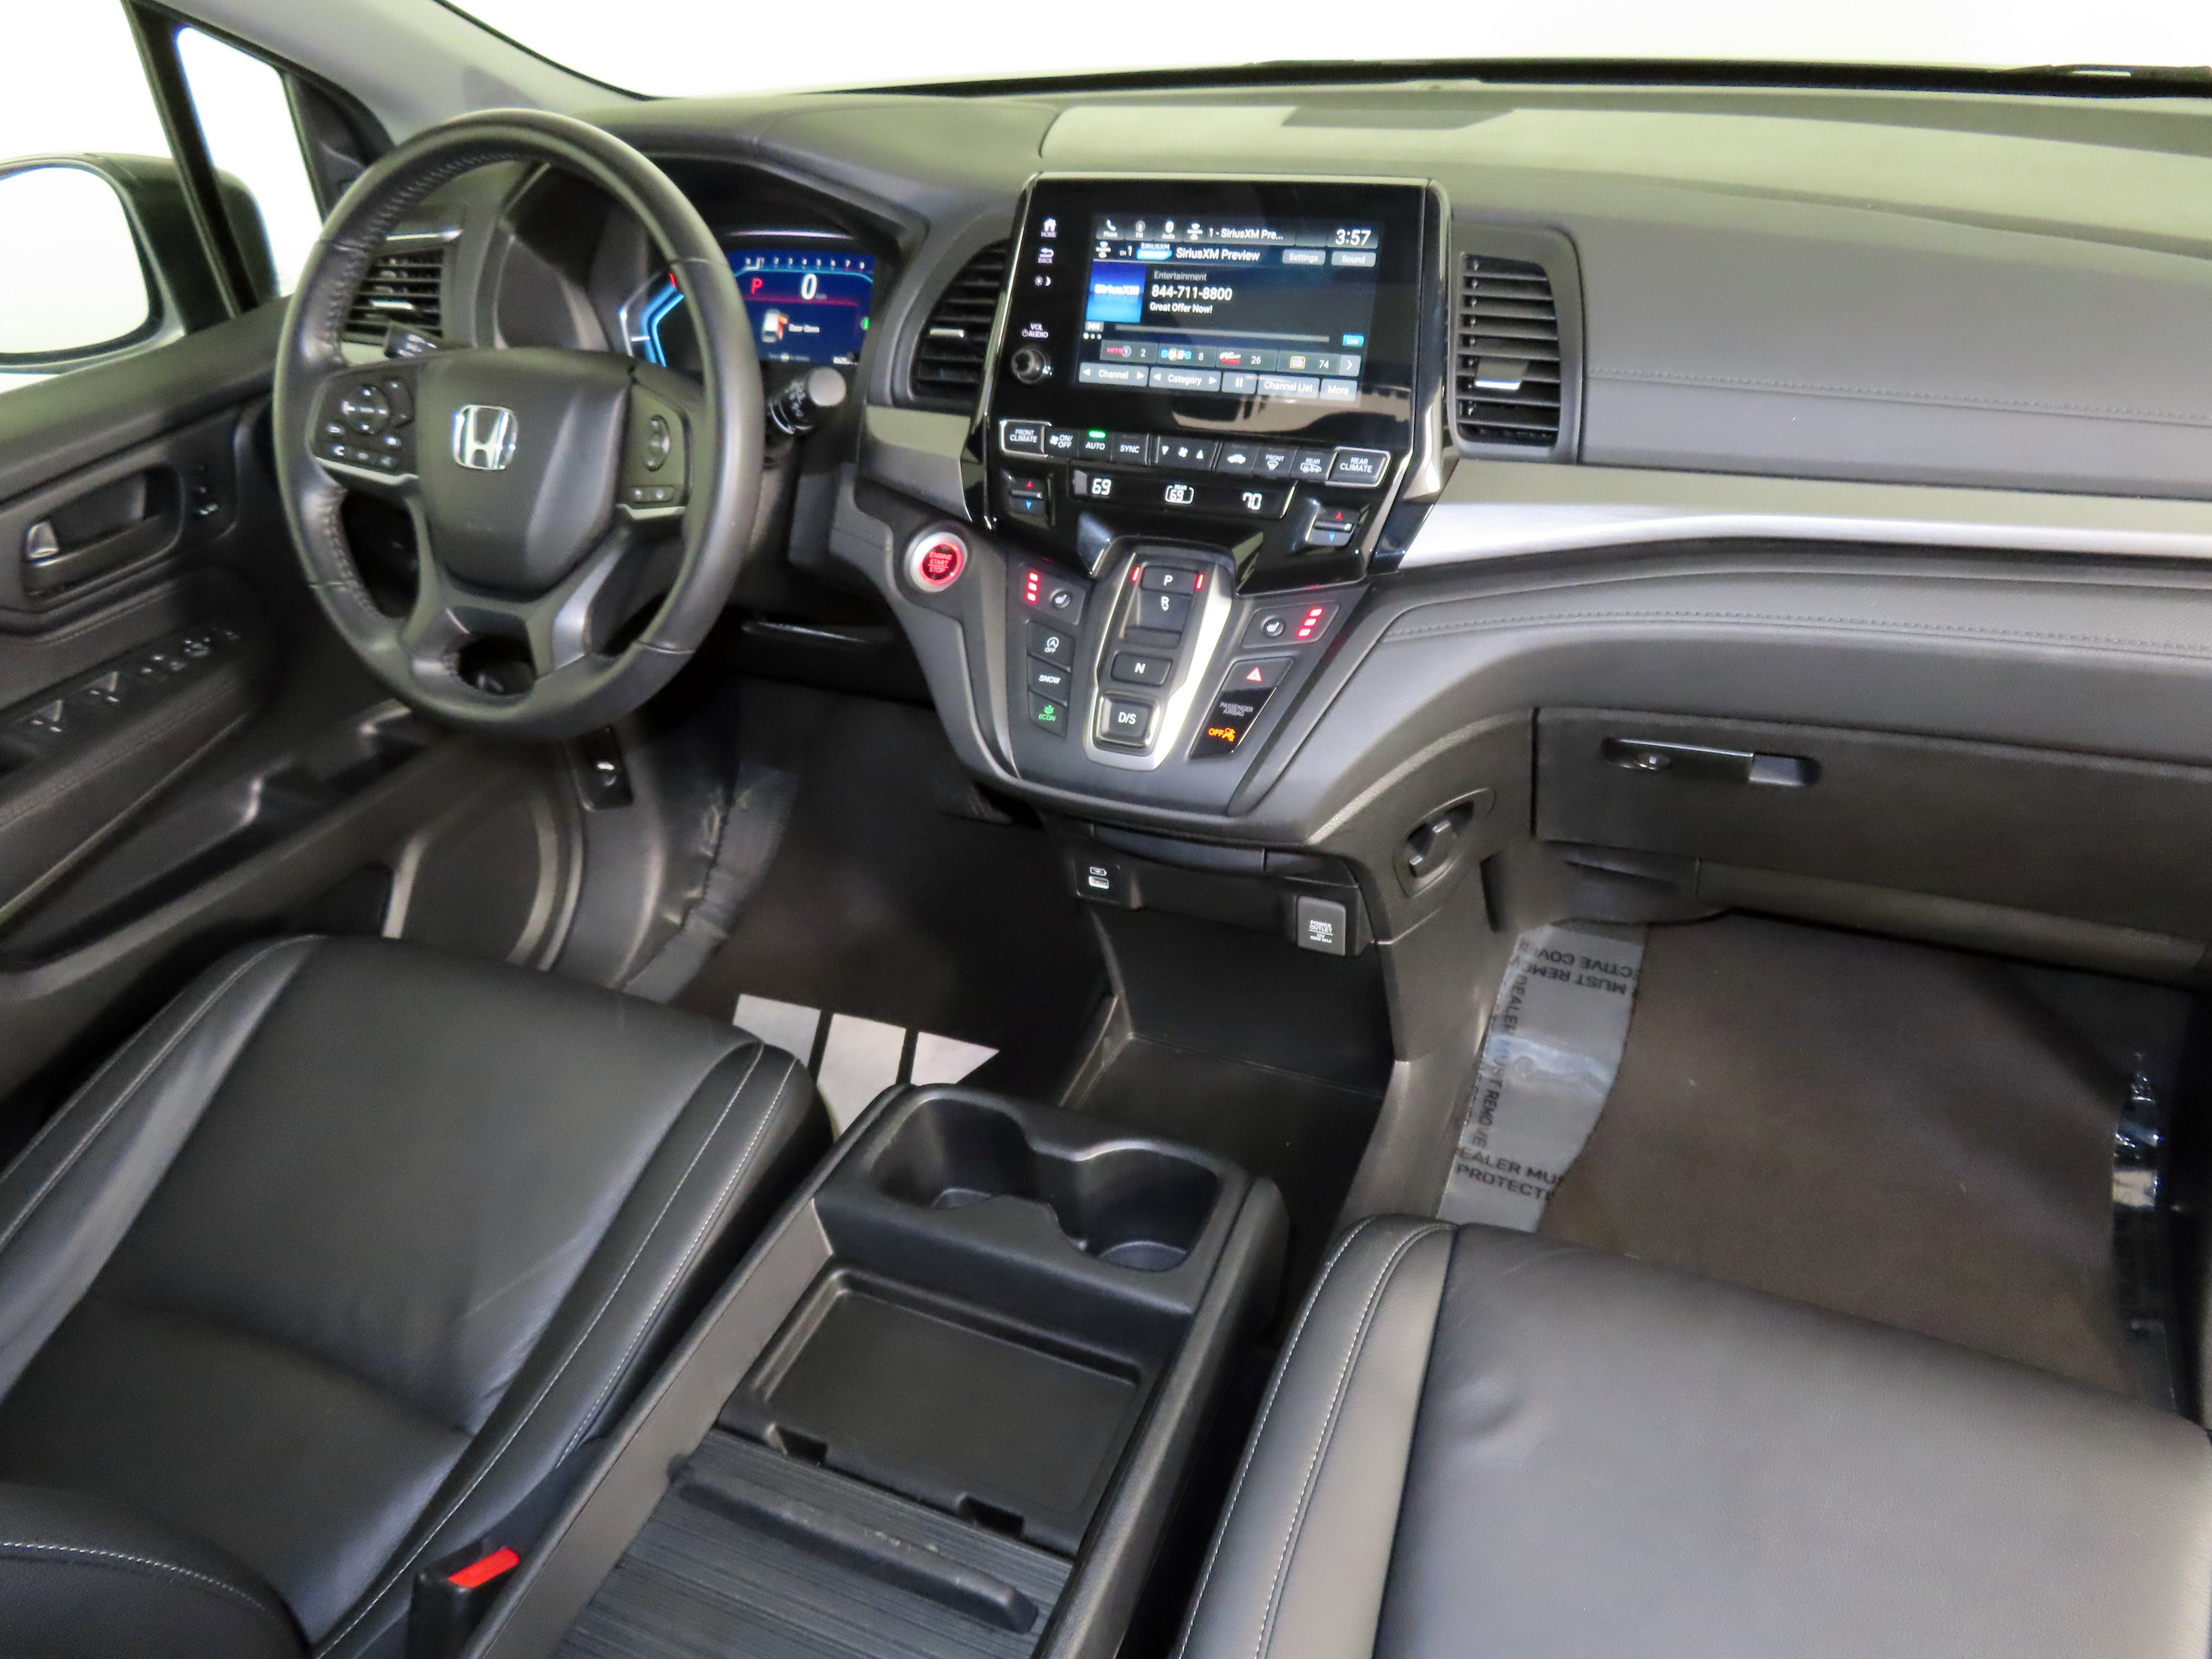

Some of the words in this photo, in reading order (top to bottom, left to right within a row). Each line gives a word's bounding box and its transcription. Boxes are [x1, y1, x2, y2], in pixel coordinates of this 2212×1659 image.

[1221, 227, 1259, 239] SiriusXM
[1335, 229, 1372, 246] 3:57
[1128, 245, 1132, 256] 1
[1176, 247, 1219, 259] SiriusXM
[1222, 248, 1260, 261] Preview
[1289, 253, 1319, 263] Settings
[1342, 255, 1366, 264] Sound
[1154, 271, 1207, 282] Entertainment
[751, 277, 763, 294] P
[801, 273, 818, 300] 0
[1094, 284, 1140, 296] SiriusXM
[1151, 284, 1233, 301] 844-711-8800
[1150, 302, 1170, 312] Great
[1172, 303, 1191, 313] Offer
[1193, 304, 1213, 314] Now!
[1030, 323, 1043, 331] VOL
[1028, 330, 1049, 338] AUDIO
[1141, 348, 1146, 358] 2
[1198, 352, 1204, 361] 8
[1251, 355, 1261, 365] 26
[1318, 360, 1329, 369] 74
[1098, 369, 1129, 380] Channel
[1168, 374, 1202, 387] Category
[1264, 381, 1297, 392] Channel
[1298, 383, 1313, 393] List
[1328, 385, 1349, 395] More
[1010, 434, 1038, 443] CLIMATE
[1086, 442, 1106, 451] AUTO
[1120, 445, 1140, 453] SYNC
[1340, 463, 1373, 473] CLIMATE
[1091, 477, 1112, 496] 69
[1170, 490, 1184, 501] 69
[1242, 492, 1263, 510] 70
[929, 552, 952, 560] ENGINE
[1164, 575, 1173, 586] P
[1161, 596, 1170, 606] R
[1135, 663, 1146, 674] N
[1039, 675, 1061, 684] SNOW
[1220, 702, 1254, 713] PASSENGER
[1223, 708, 1245, 716] AIRBAG
[1038, 713, 1056, 722] ECON
[1118, 712, 1136, 725] D/S
[1208, 728, 1224, 737] OFF
[1310, 920, 1332, 928] POWER
[1310, 924, 1333, 933] OUTLET
[1537, 949, 1575, 966] COV
[1580, 957, 1633, 978] CTIVE
[1575, 975, 1626, 995] MUST
[1472, 1089, 1500, 1148] REMOVE
[1459, 1147, 1522, 1173] EALER
